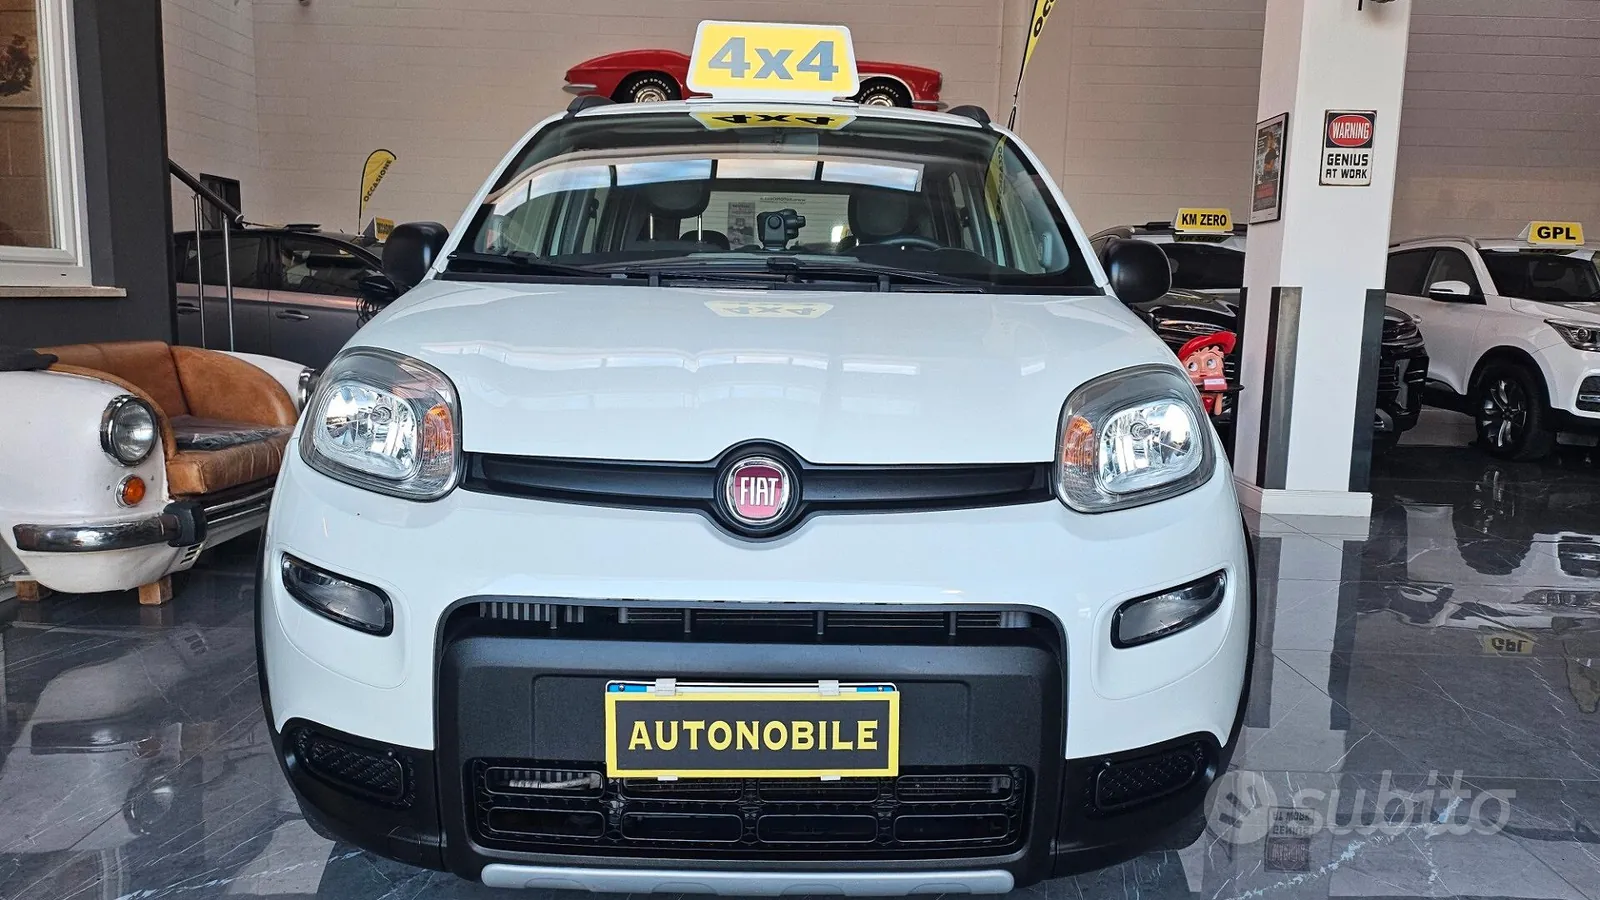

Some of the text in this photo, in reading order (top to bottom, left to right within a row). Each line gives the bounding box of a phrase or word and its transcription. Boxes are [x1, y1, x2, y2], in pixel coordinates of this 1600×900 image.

[1034, 0, 1054, 37] OC
[708, 37, 839, 81] 4x4
[1332, 122, 1370, 139] WARNING
[1326, 153, 1369, 166] GENIUS
[363, 160, 393, 202] OCCASIONE
[1325, 168, 1368, 179] AT WORK
[1181, 213, 1227, 226] KM ZERO
[1537, 226, 1576, 240] GPL
[740, 477, 779, 506] FIAT
[628, 720, 878, 751] AUTONOBILE
